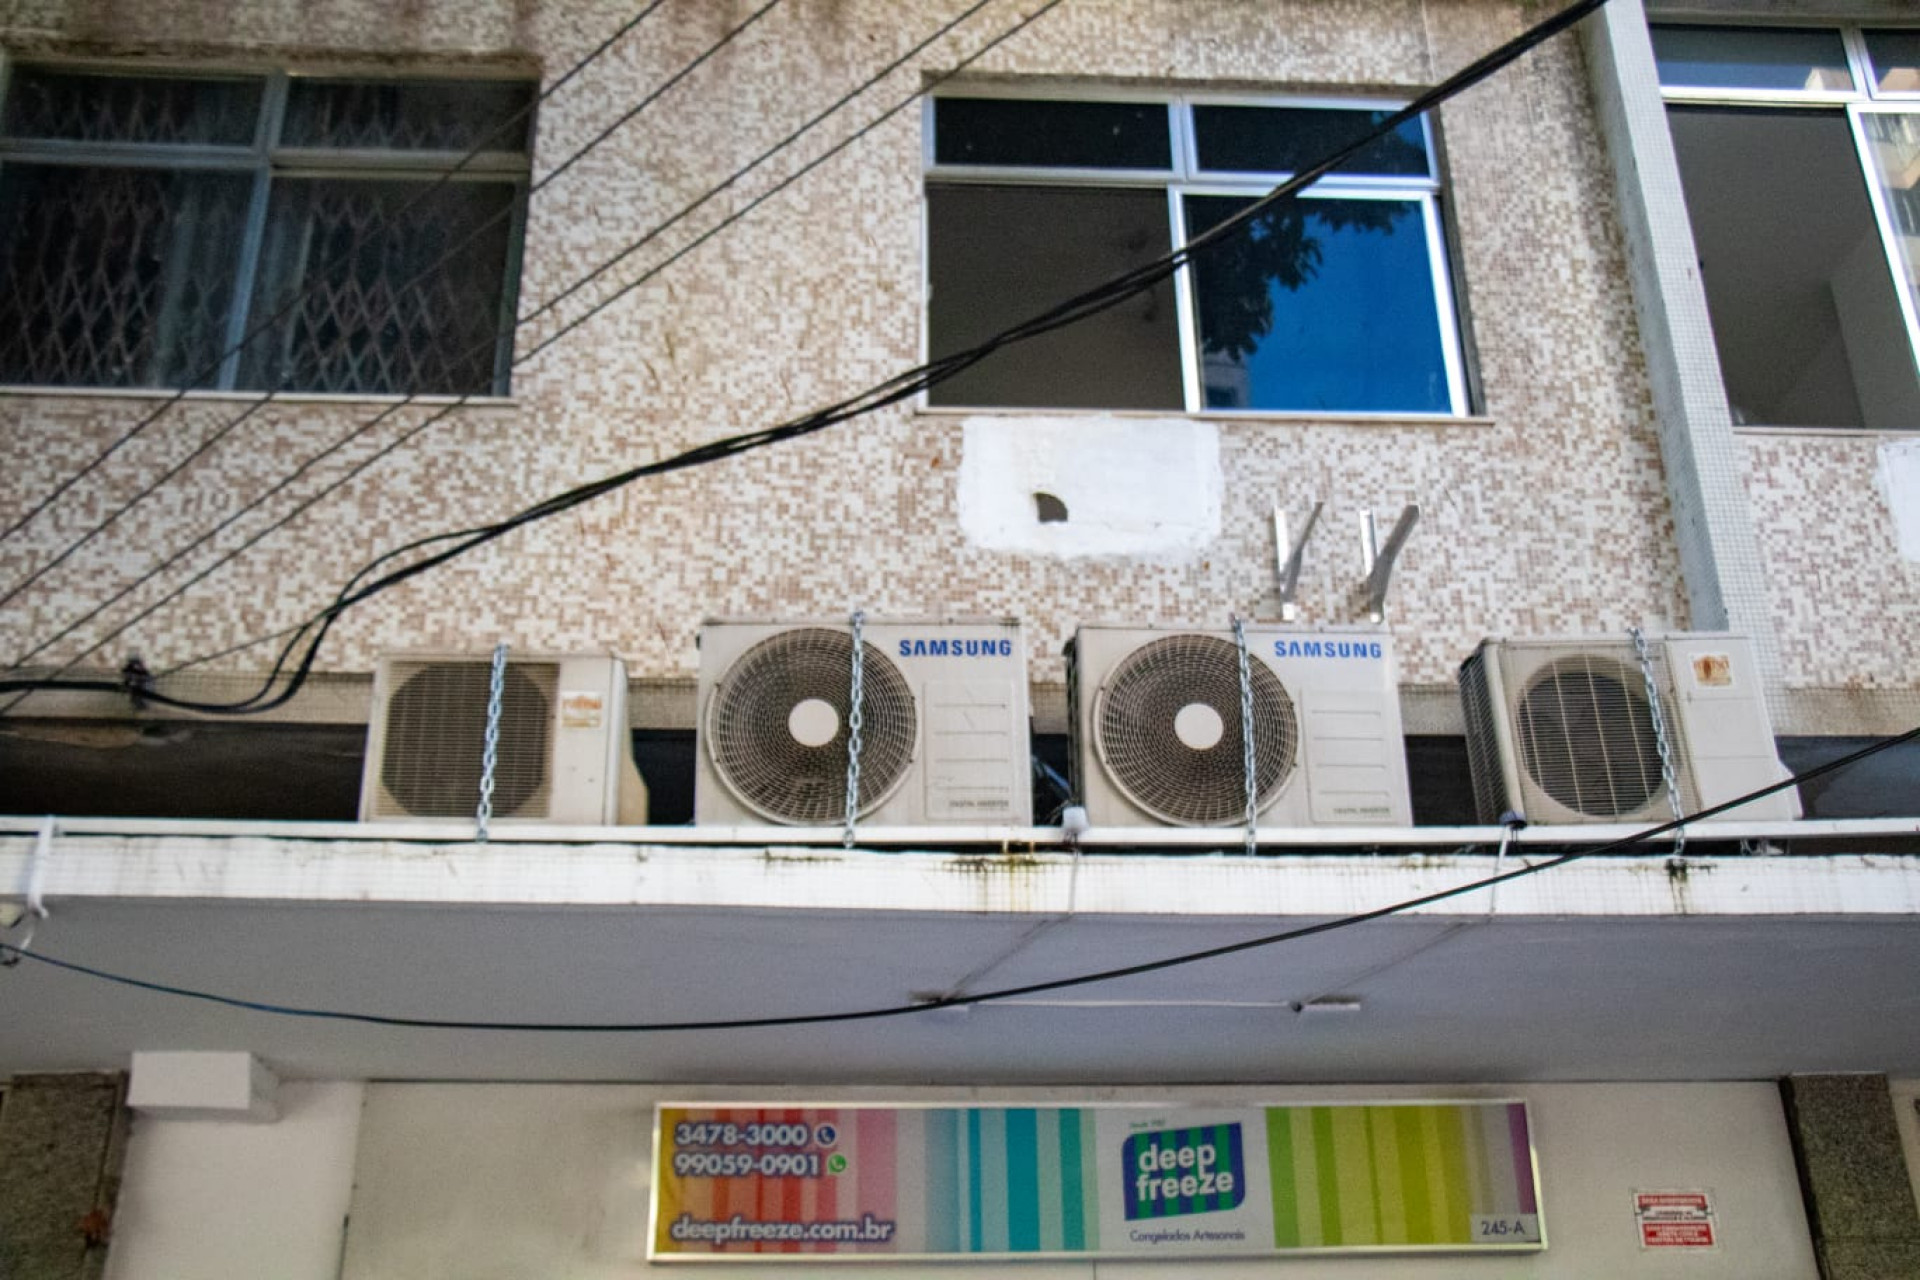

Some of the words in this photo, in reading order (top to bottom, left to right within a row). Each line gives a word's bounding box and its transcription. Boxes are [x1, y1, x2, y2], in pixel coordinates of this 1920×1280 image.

[899, 639, 1012, 657] SAMSUNG
[1274, 641, 1382, 658] SAMSUNG
[675, 1124, 808, 1146] 3478-3000
[675, 1153, 820, 1176] 99059-0901
[1138, 1143, 1216, 1180] deep
[1136, 1171, 1234, 1201] freeze
[672, 1214, 892, 1245] deepfreeze.com.br
[1481, 1220, 1526, 1236] 245-A
